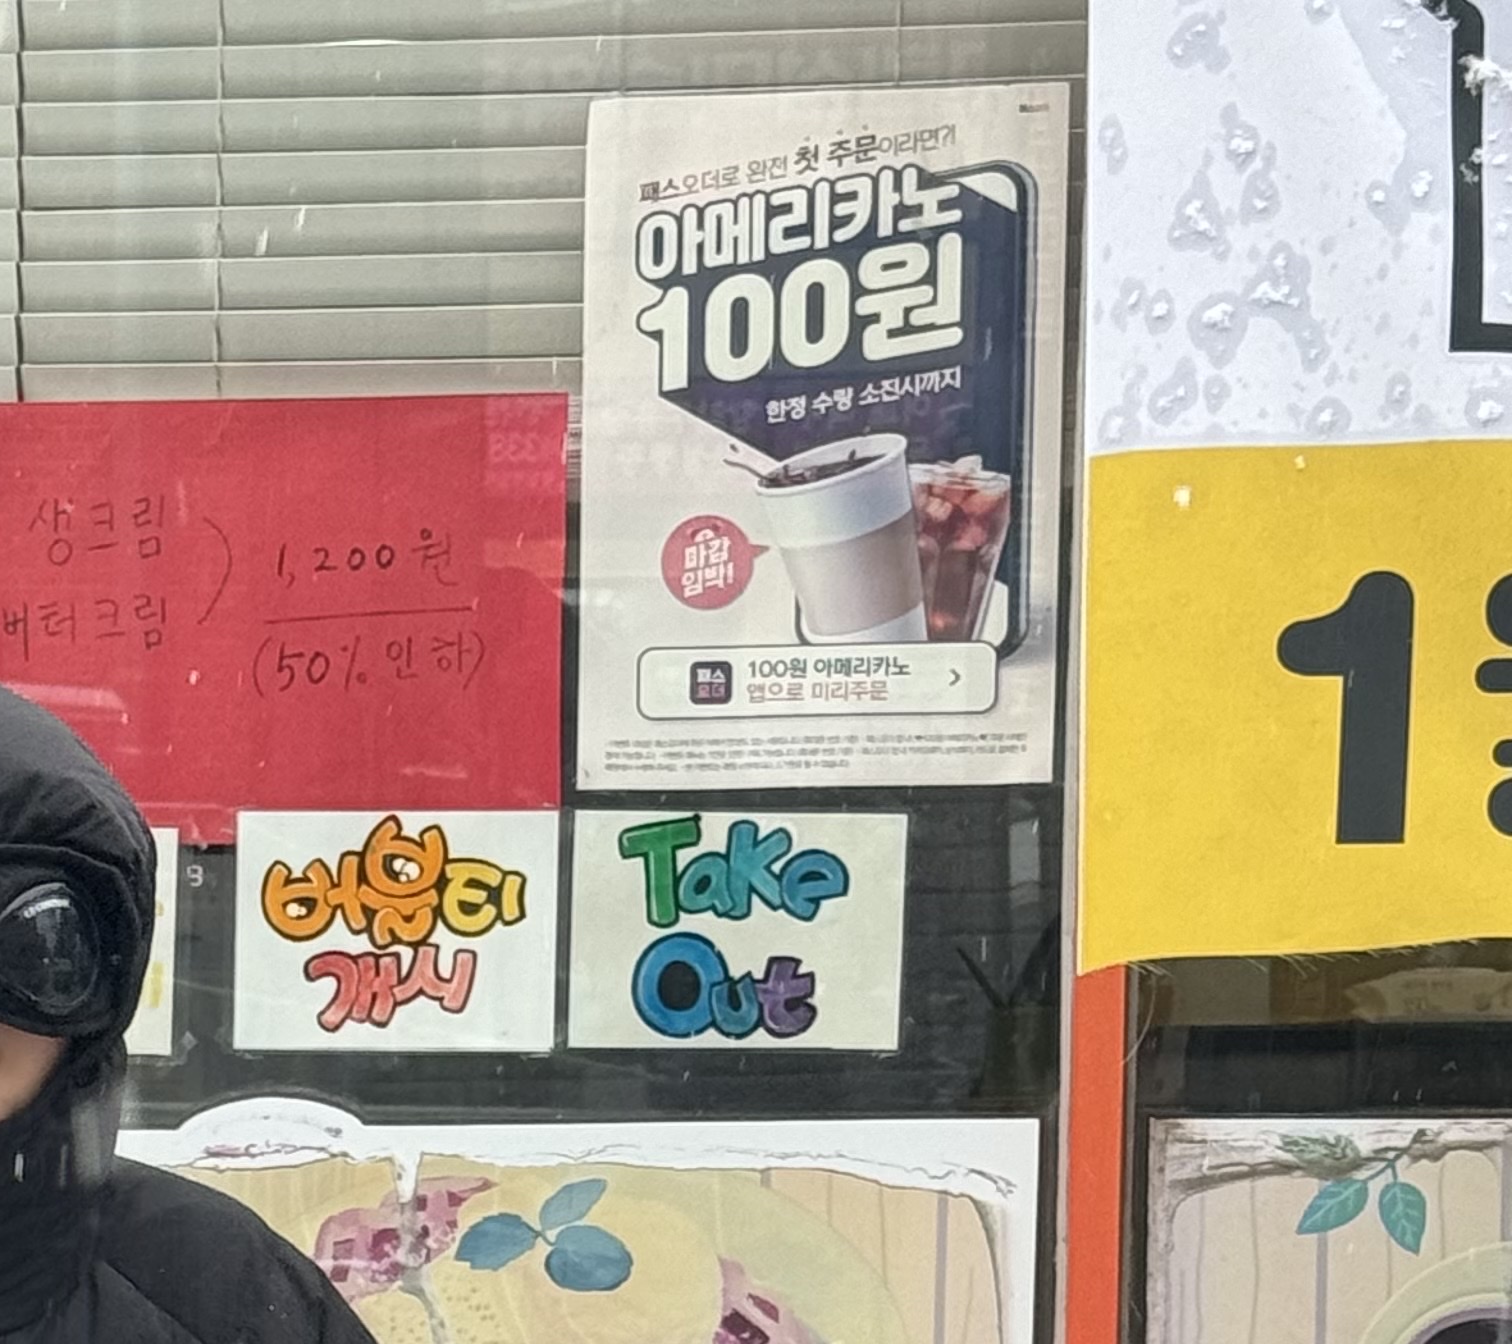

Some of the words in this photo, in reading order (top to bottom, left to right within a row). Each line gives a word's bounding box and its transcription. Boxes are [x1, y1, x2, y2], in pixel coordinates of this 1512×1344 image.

[745, 155, 788, 184] 완전
[793, 144, 820, 175] 첫
[635, 163, 965, 281] 아메리카노
[636, 230, 965, 393] 100원
[765, 394, 807, 424] 한정
[811, 386, 854, 415] 수량
[858, 364, 962, 406] 소진시까지
[29, 494, 166, 567] 생크림
[683, 536, 731, 570] 마감
[1, 593, 167, 662] 버터크림
[746, 681, 805, 703] 앱으로
[811, 680, 889, 702] 미리주문
[747, 657, 808, 679] 100원
[812, 656, 912, 678] 아메리카노
[260, 814, 527, 949] 버블티
[618, 813, 850, 928] Take
[303, 943, 478, 1033] 개시
[631, 932, 817, 1039] Out
